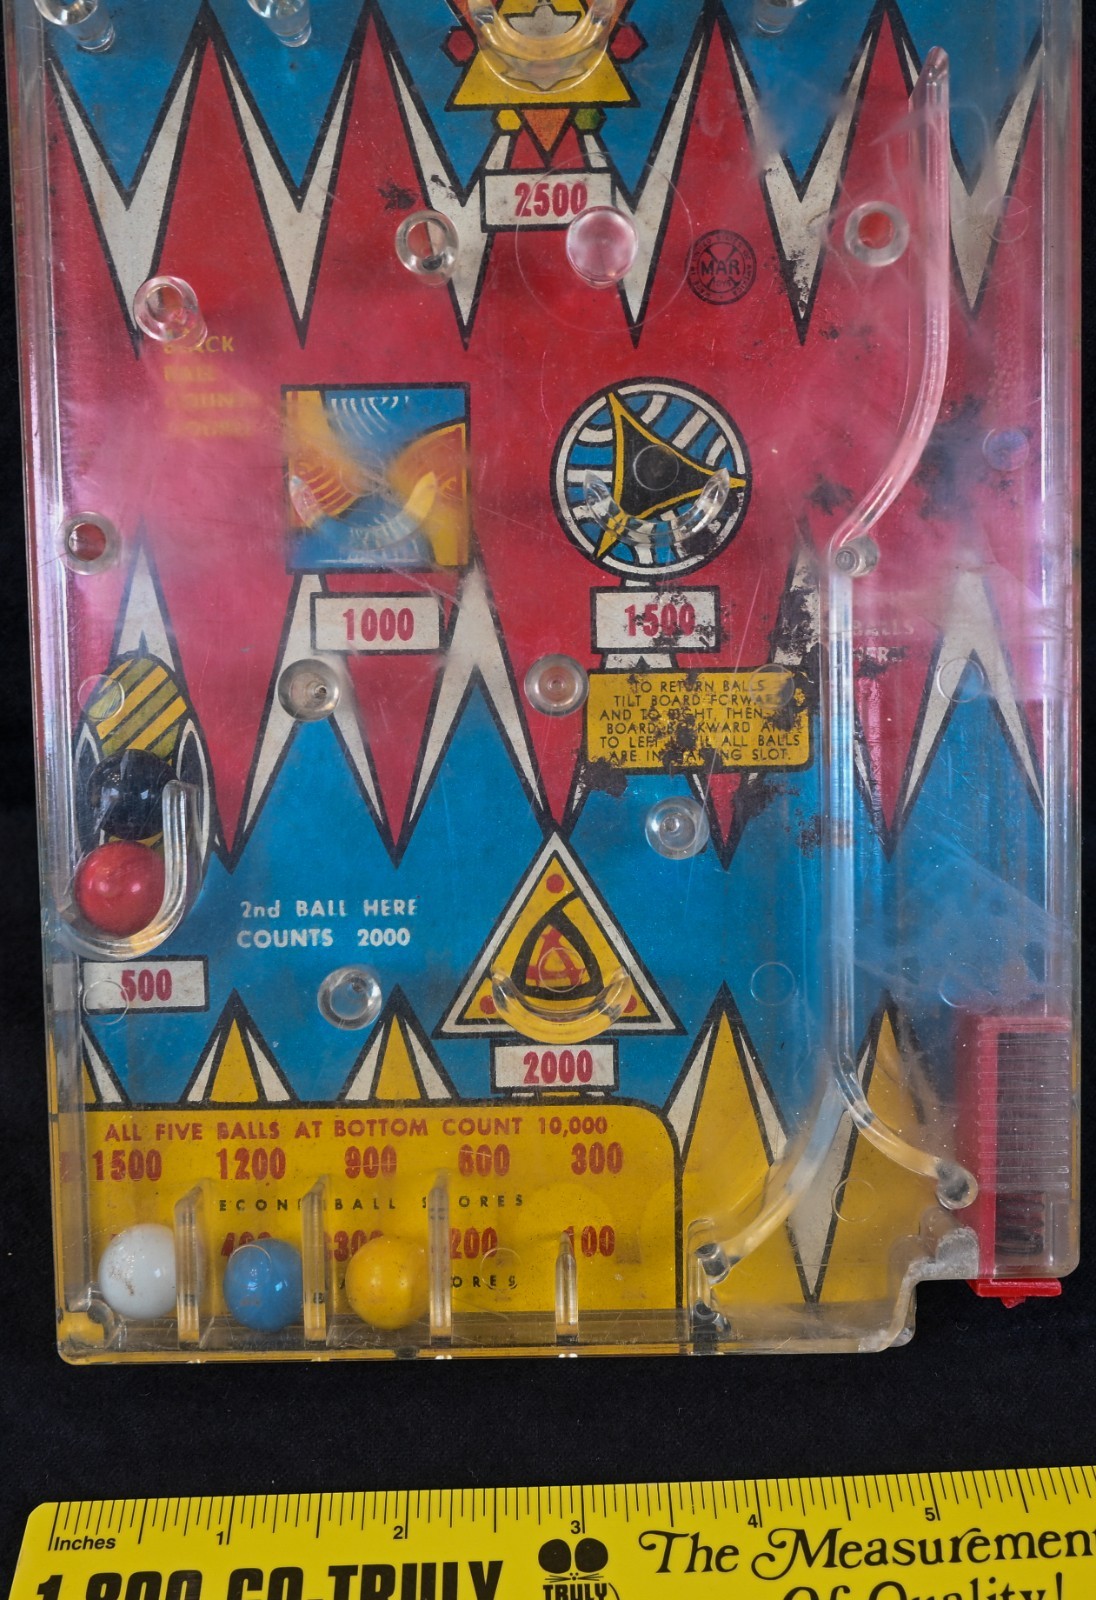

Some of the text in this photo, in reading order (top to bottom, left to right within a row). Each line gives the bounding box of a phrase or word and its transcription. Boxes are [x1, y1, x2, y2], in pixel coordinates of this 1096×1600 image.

[515, 182, 588, 217] 2500
[701, 260, 740, 276] MAR
[342, 607, 415, 642] 1000
[624, 602, 696, 637] 1500
[660, 680, 714, 692] RETURN
[723, 680, 765, 692] BALLS
[613, 695, 642, 707] TILT
[651, 694, 701, 706] BOARD
[599, 709, 632, 721] AND
[640, 708, 661, 720] TO
[726, 707, 763, 720] THEN
[607, 722, 657, 735] BOARD
[667, 721, 751, 734] BKWARD
[600, 736, 620, 749] TO
[629, 736, 659, 749] LEFT
[721, 735, 749, 747] ALL
[758, 734, 800, 747] BALLS
[610, 750, 638, 762] ARE
[752, 748, 792, 761] SLOT.
[240, 899, 418, 919] 2nd BALL HERE
[237, 927, 411, 948] COUNTS 2000
[120, 968, 173, 1002] 500
[523, 1049, 593, 1084] 2000
[104, 1116, 608, 1142] ALL FIVE BALLS AT BOTTOM COUNT 10,000
[92, 1141, 624, 1182] 1500 1200 900 600 300
[219, 1194, 524, 1212] ECON BALL SORES
[334, 1229, 384, 1262] 30
[449, 1226, 498, 1259] 200
[451, 1275, 517, 1288] ORES
[746, 1513, 759, 1529] 4
[924, 1507, 936, 1522] 5
[392, 1525, 404, 1540] 2
[570, 1519, 581, 1535] 3
[53, 1536, 117, 1551] Inches
[216, 1531, 225, 1546] 1
[638, 1526, 1096, 1580] The Measuremen
[542, 1582, 608, 1600] TRULY
